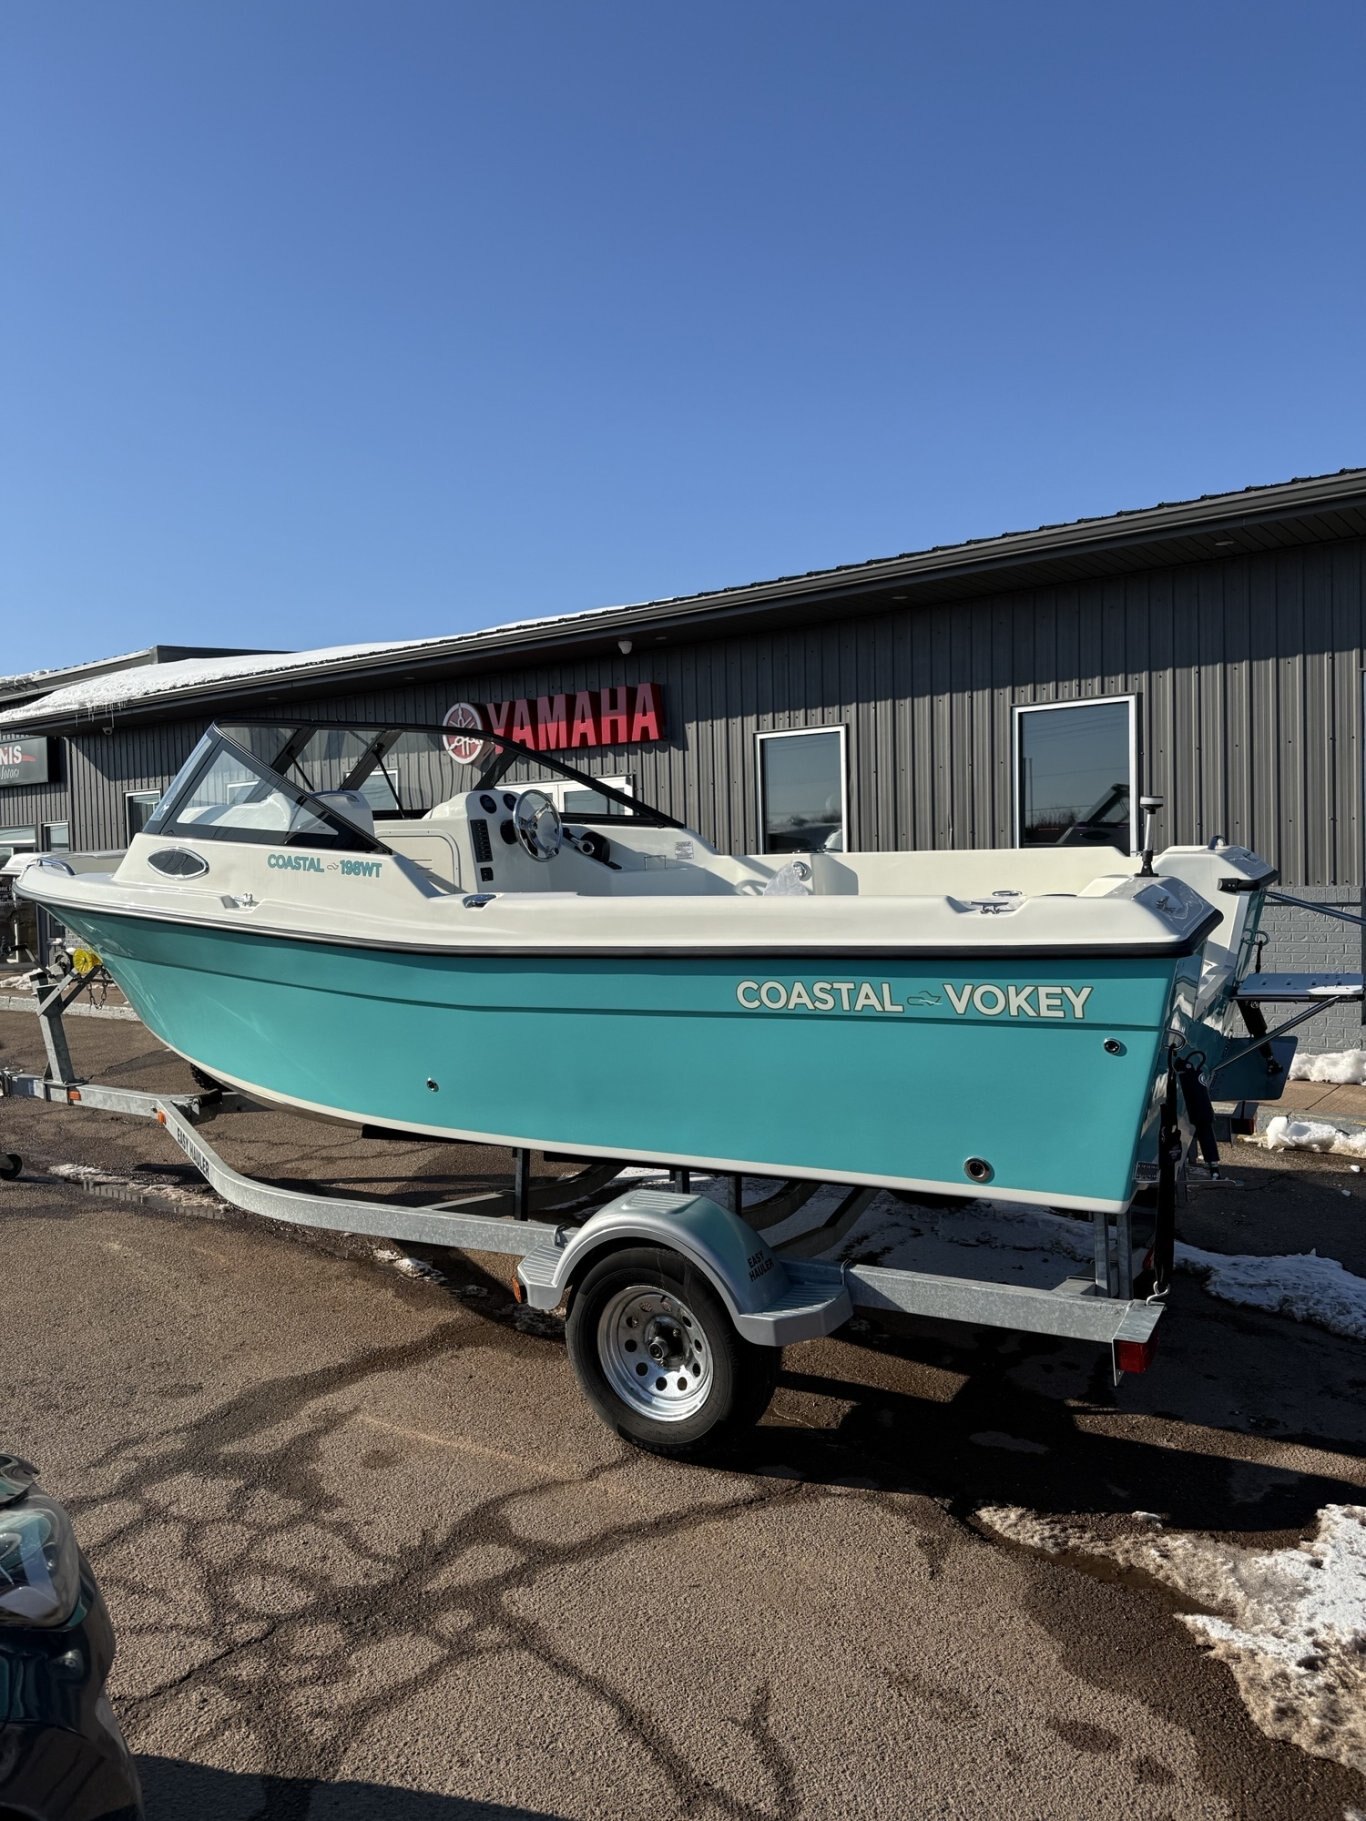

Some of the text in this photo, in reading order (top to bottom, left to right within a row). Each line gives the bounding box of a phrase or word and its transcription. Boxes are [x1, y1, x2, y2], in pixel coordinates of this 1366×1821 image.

[486, 682, 659, 755] YAMAHA
[267, 853, 325, 873] COASTAL
[736, 980, 1094, 1019] COASTAL VOKEY
[177, 1127, 189, 1154] EASY
[747, 1250, 764, 1268] EASY
[749, 1258, 774, 1282] HAULER
